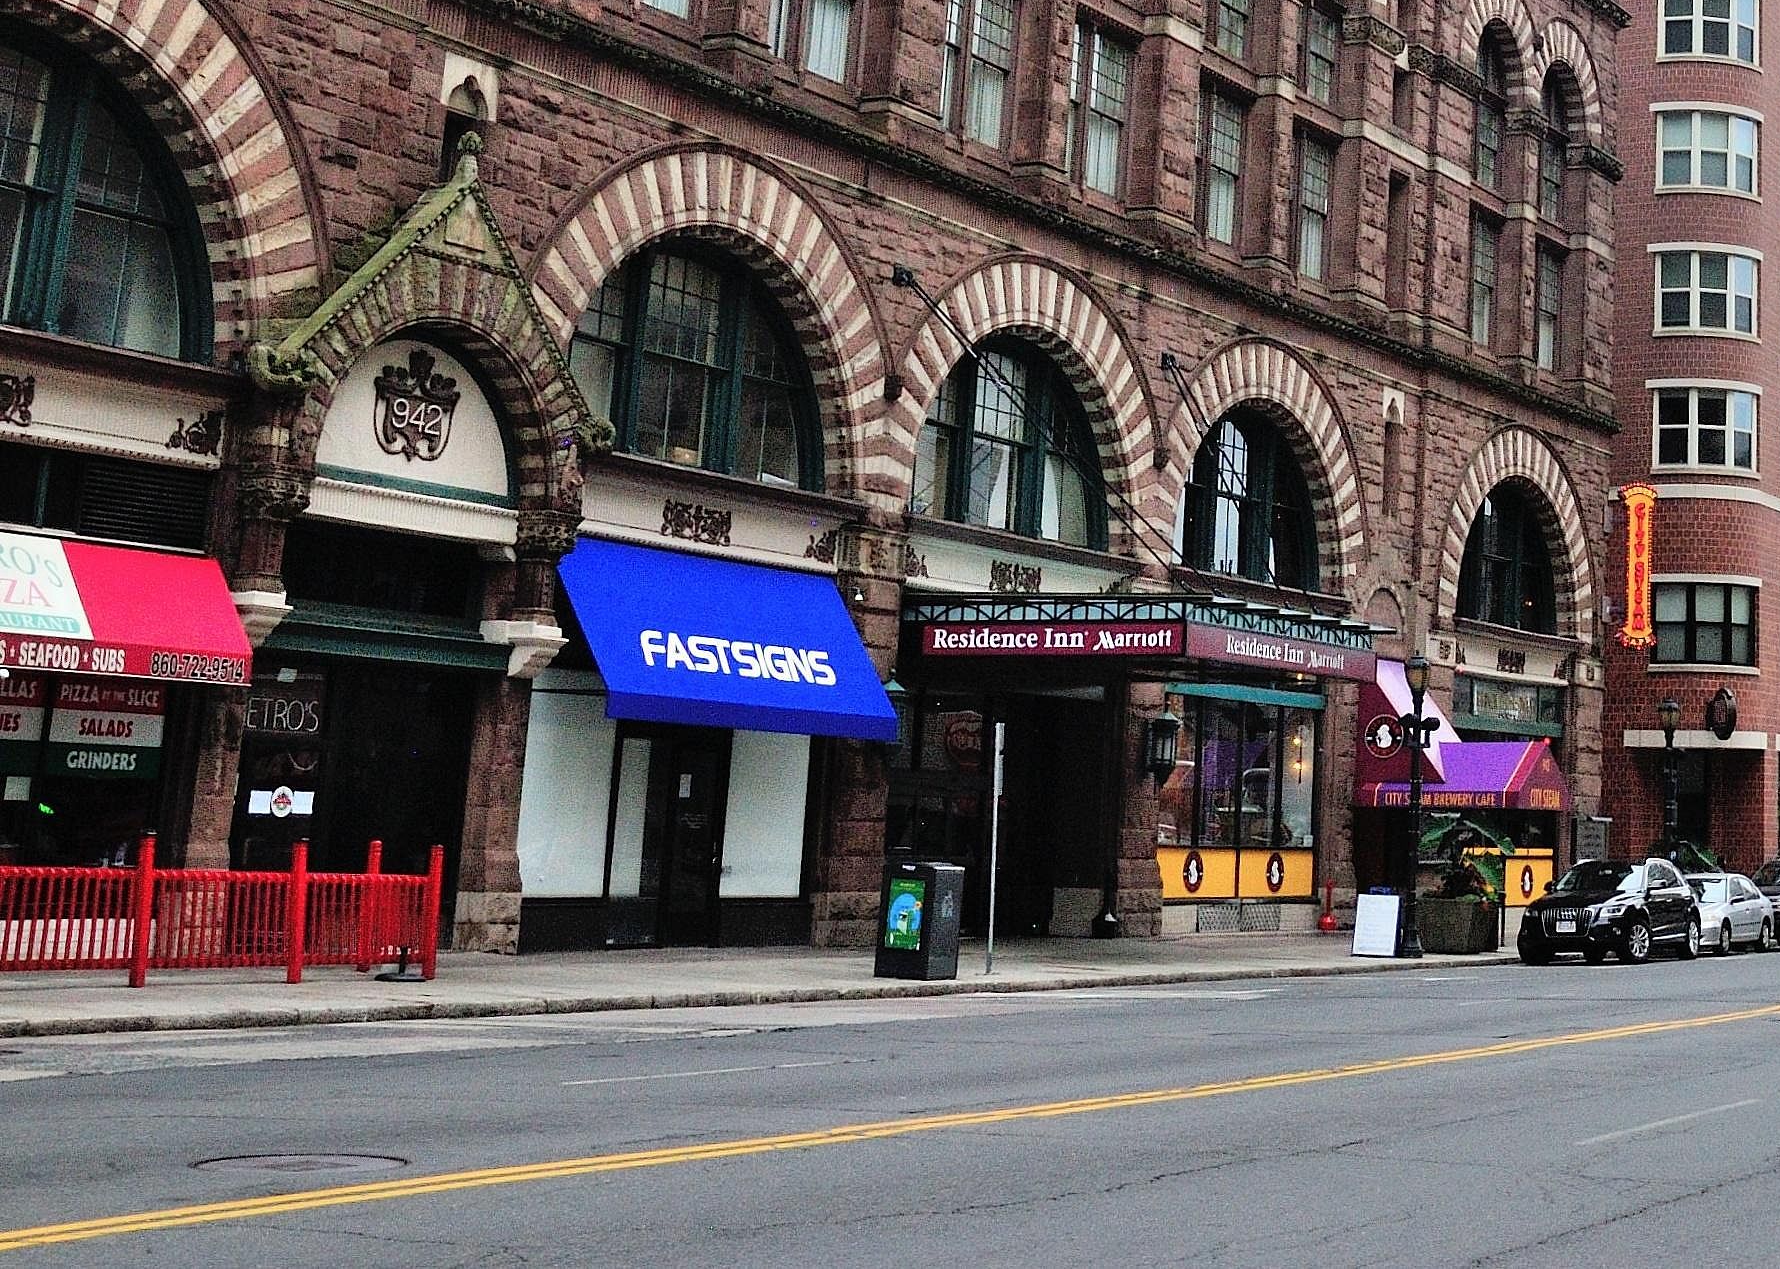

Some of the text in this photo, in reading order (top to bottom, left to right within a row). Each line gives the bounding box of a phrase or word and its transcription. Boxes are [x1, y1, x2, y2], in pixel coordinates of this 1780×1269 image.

[391, 397, 442, 436] 942
[1634, 502, 1646, 558] CITY
[932, 627, 1172, 651] Residence Inn Marriott
[1225, 633, 1344, 671] Residence Inn Marriott
[18, 641, 80, 669] SEAFOOD
[92, 647, 125, 672] SUBS
[151, 651, 244, 683] 860-722-9514
[639, 629, 837, 686] FASTSIGNS
[60, 683, 99, 703] PIZZA
[127, 689, 160, 708] SLICE
[78, 718, 134, 738] SALADS
[66, 751, 137, 771] GRINDERS
[1385, 792, 1496, 808] CITY SAM BREWERY CAFE
